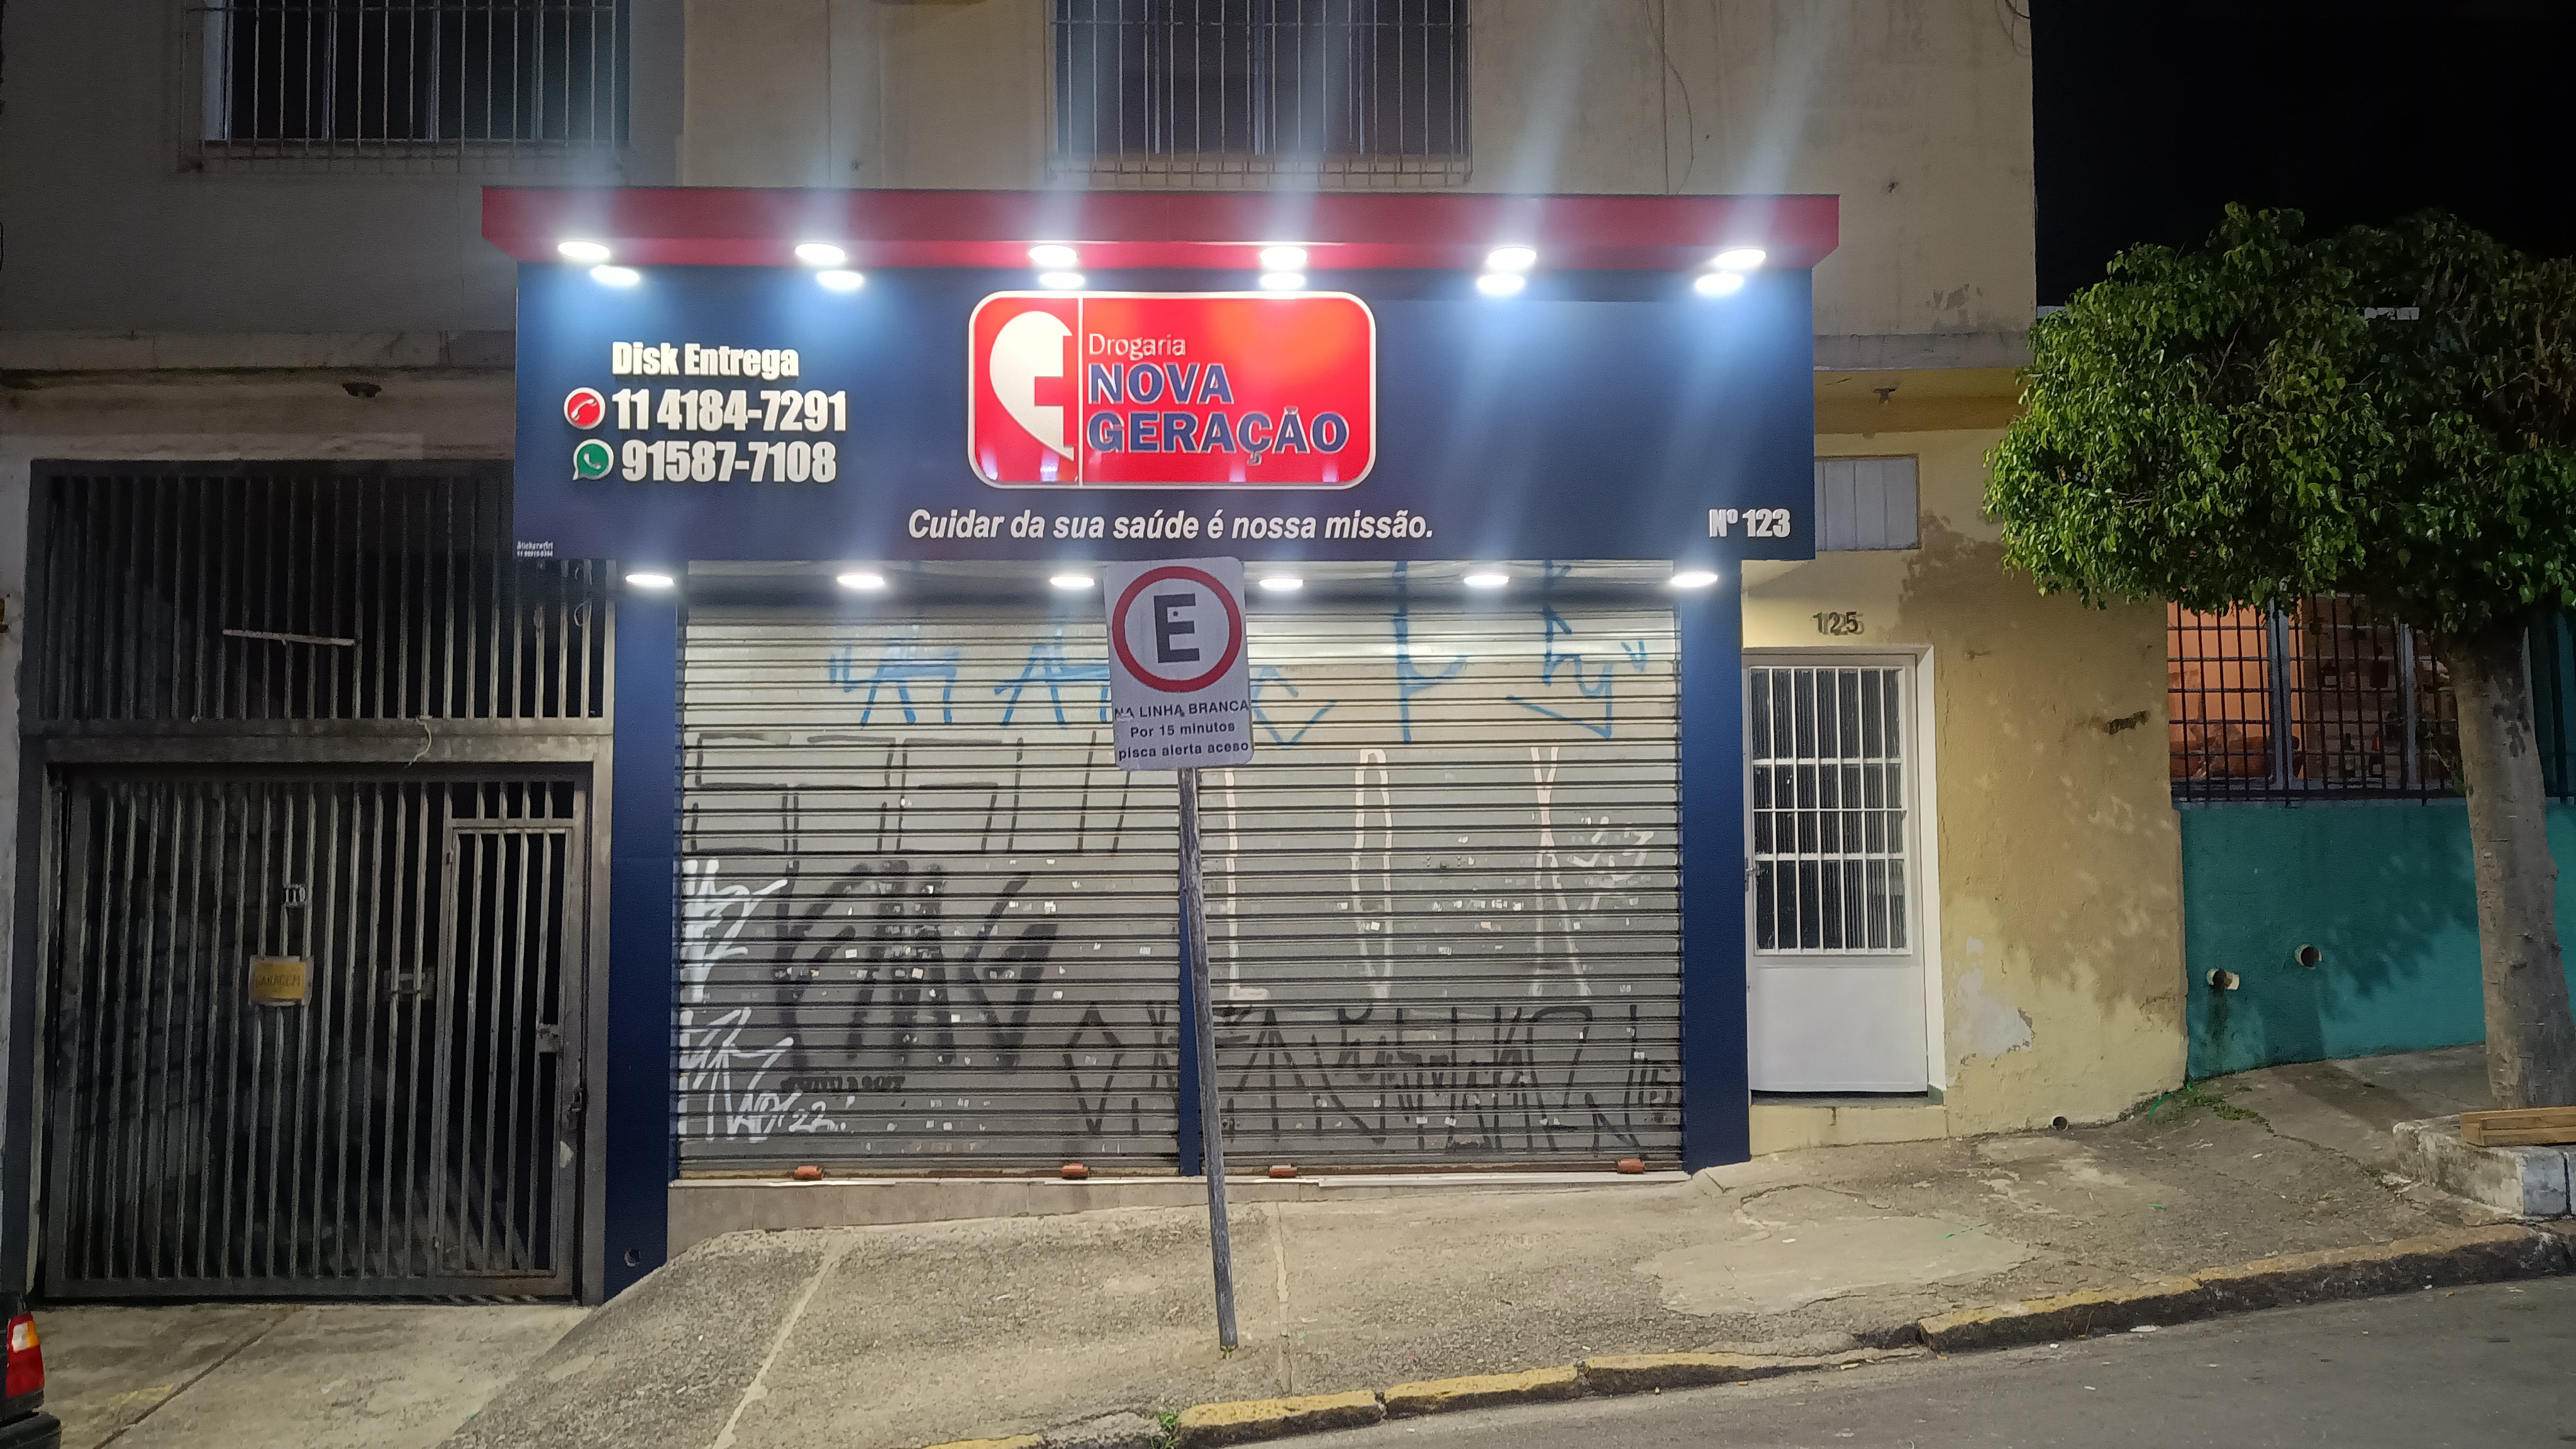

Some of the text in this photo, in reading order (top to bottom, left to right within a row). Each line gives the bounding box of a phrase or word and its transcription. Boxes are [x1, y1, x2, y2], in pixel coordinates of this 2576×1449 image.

[611, 341, 799, 380] Disk Entrega
[1089, 333, 1186, 360] Drogaria
[1088, 362, 1235, 405] NOVA
[612, 388, 847, 431] 11 4184-7291
[1086, 406, 1350, 465] GERAÇÃO
[621, 439, 836, 482] 91587-7108
[908, 508, 1433, 539] Cuidar da sua saúde é nossa missão.
[1742, 508, 1791, 538] 123
[1153, 593, 1200, 663] E
[1811, 611, 1866, 636] 125
[1114, 700, 1250, 721] NA LINHA BRANCA
[1130, 721, 1236, 738] Por 15 minutos
[1118, 741, 1249, 762] pisca alerta aceso
